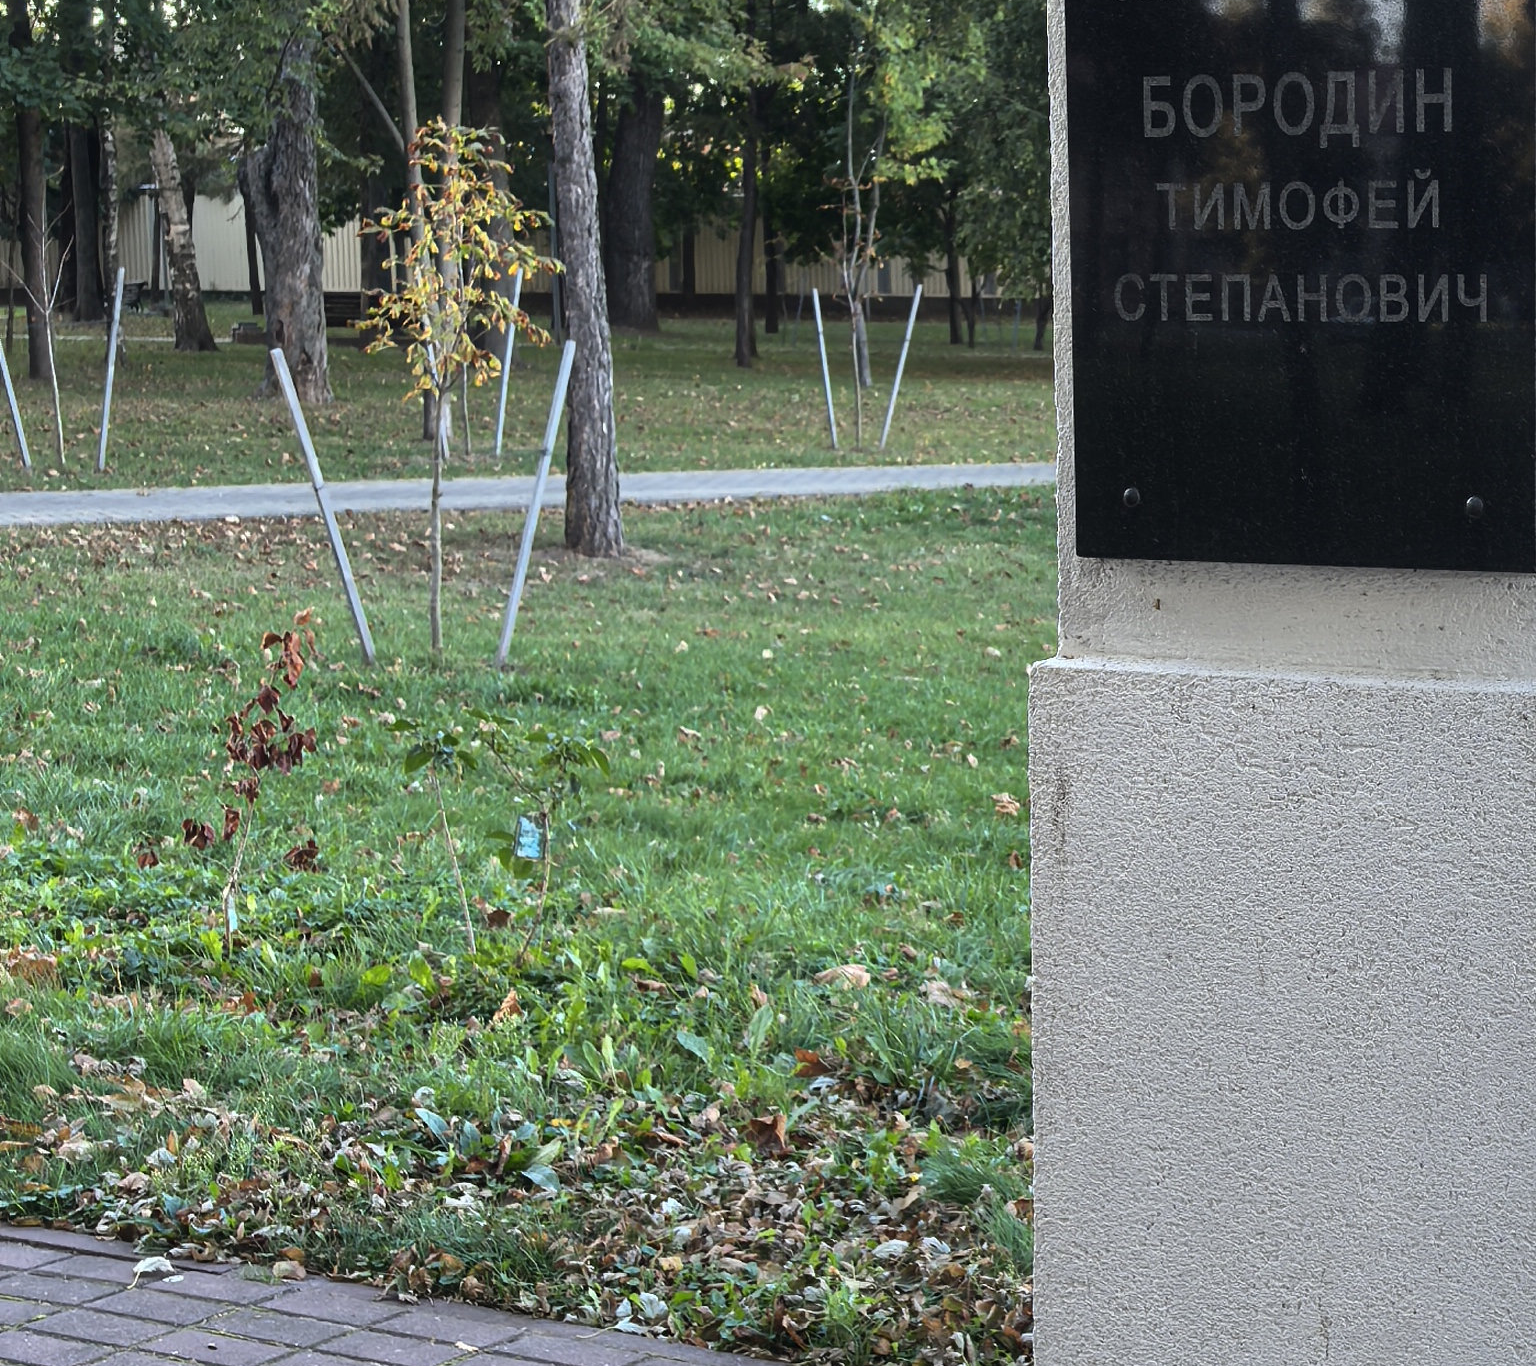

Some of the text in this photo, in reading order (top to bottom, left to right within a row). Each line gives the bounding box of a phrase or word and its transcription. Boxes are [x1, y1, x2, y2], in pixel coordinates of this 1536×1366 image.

[1142, 67, 1453, 148] БОРОДИН
[1156, 168, 1441, 230] ТИМОФЕЙ
[1113, 272, 1489, 324] СТЕПАНОВИЧ
